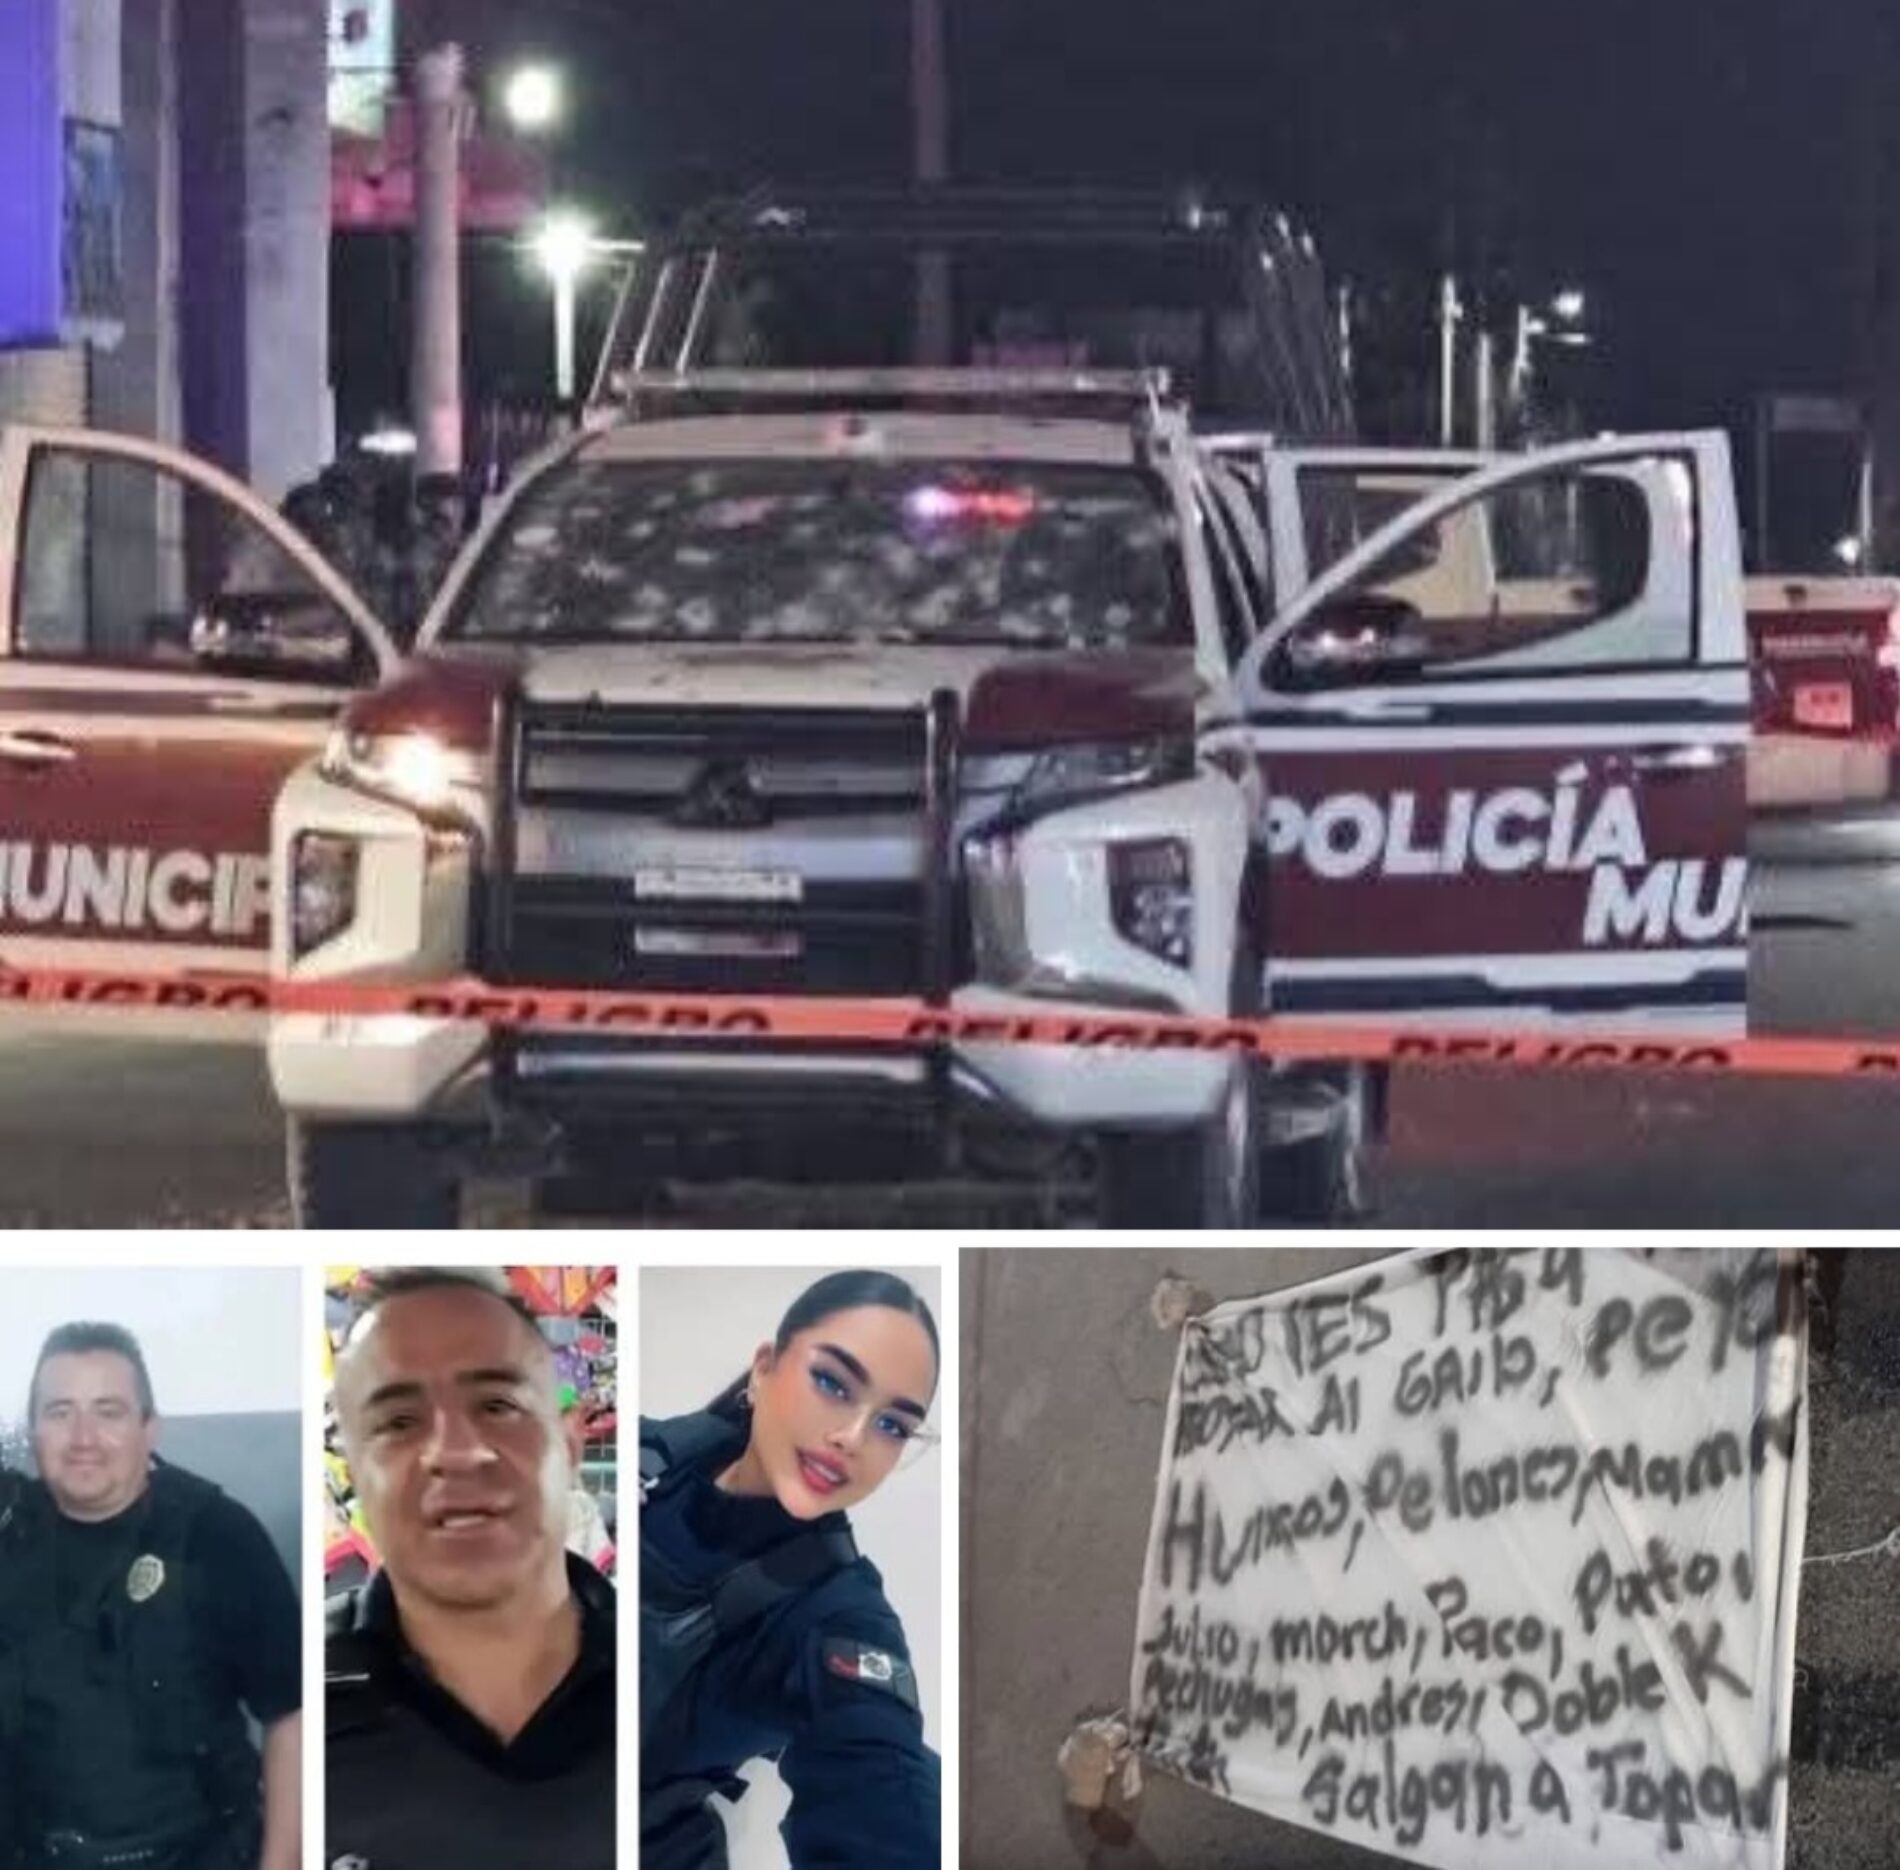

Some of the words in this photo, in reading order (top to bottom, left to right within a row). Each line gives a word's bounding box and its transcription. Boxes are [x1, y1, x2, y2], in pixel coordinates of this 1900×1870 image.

[1263, 760, 1649, 878] POLICÍA
[0, 840, 271, 936] UNICIP
[1582, 858, 1747, 947] MU
[1668, 1617, 1752, 1706] K
